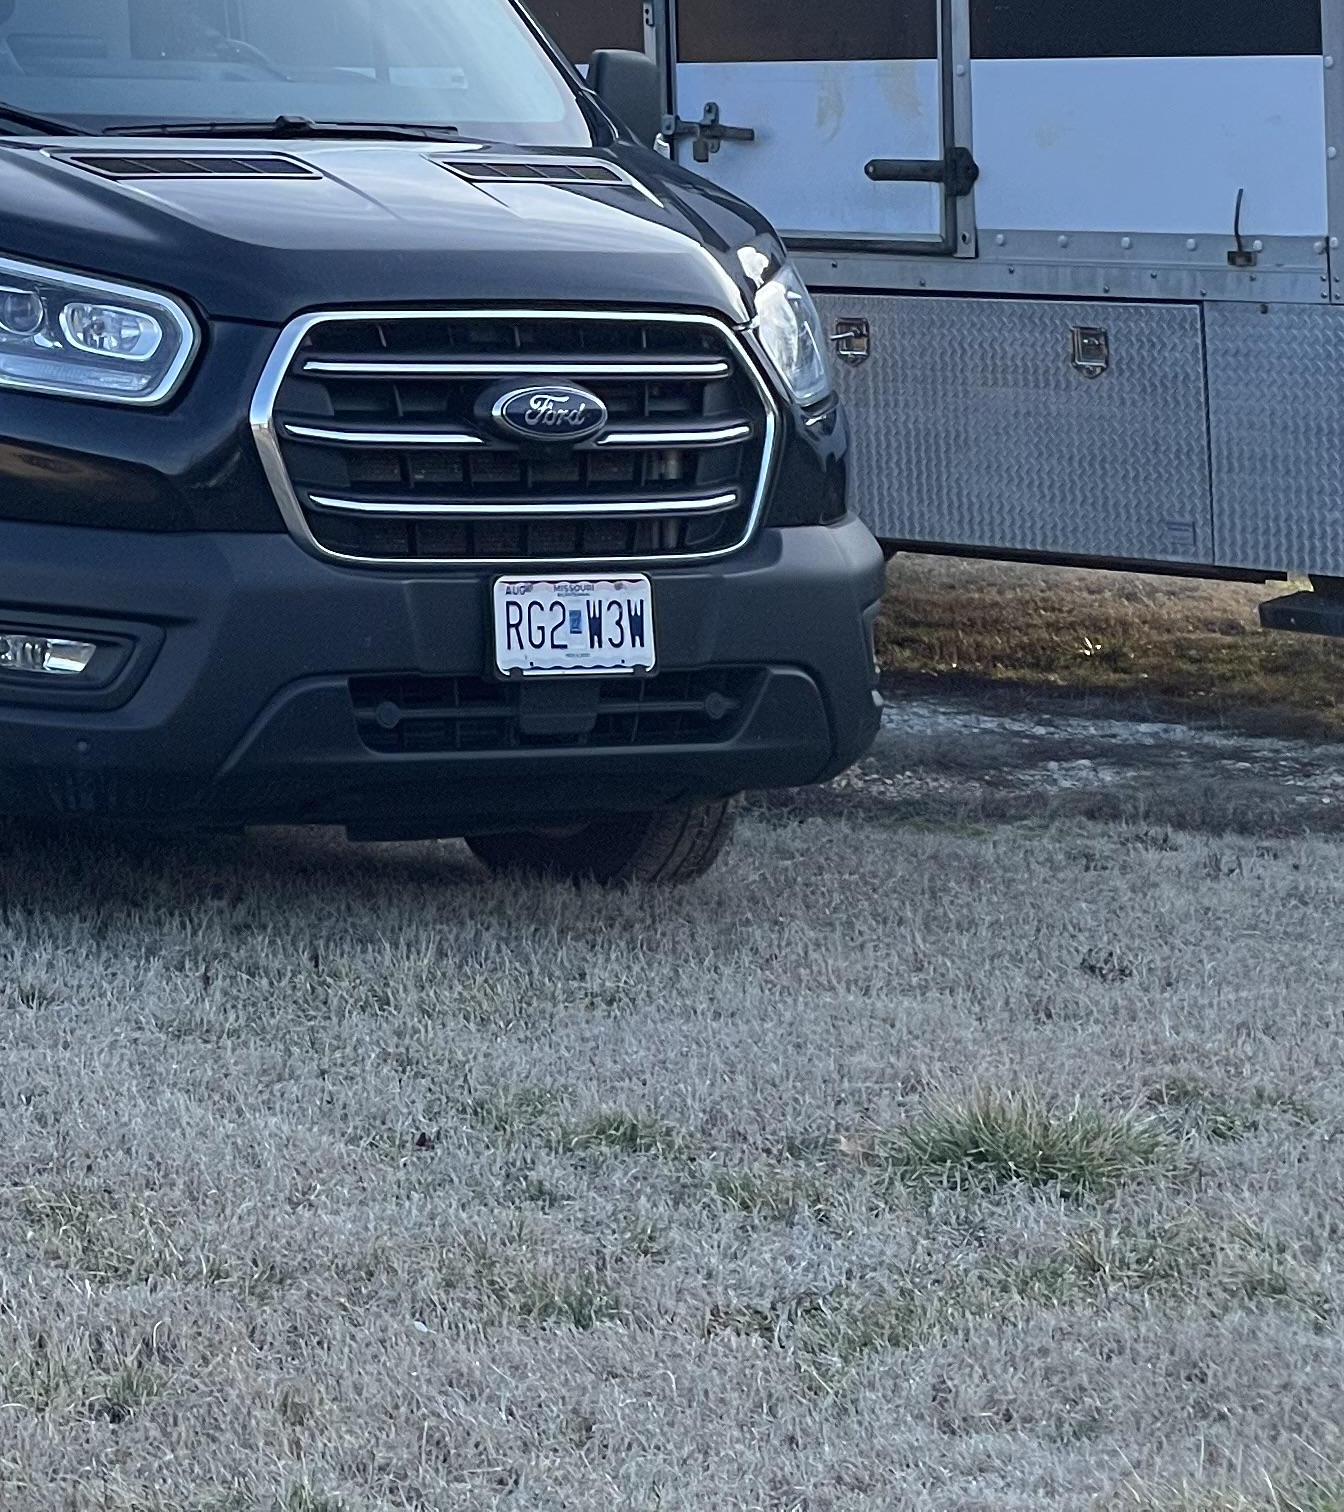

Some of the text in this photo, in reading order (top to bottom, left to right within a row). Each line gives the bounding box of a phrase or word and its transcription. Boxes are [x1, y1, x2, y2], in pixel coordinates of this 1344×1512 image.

[524, 394, 586, 425] Ford
[553, 584, 594, 592] MISSOURI
[505, 599, 645, 650] RG2 W3W
